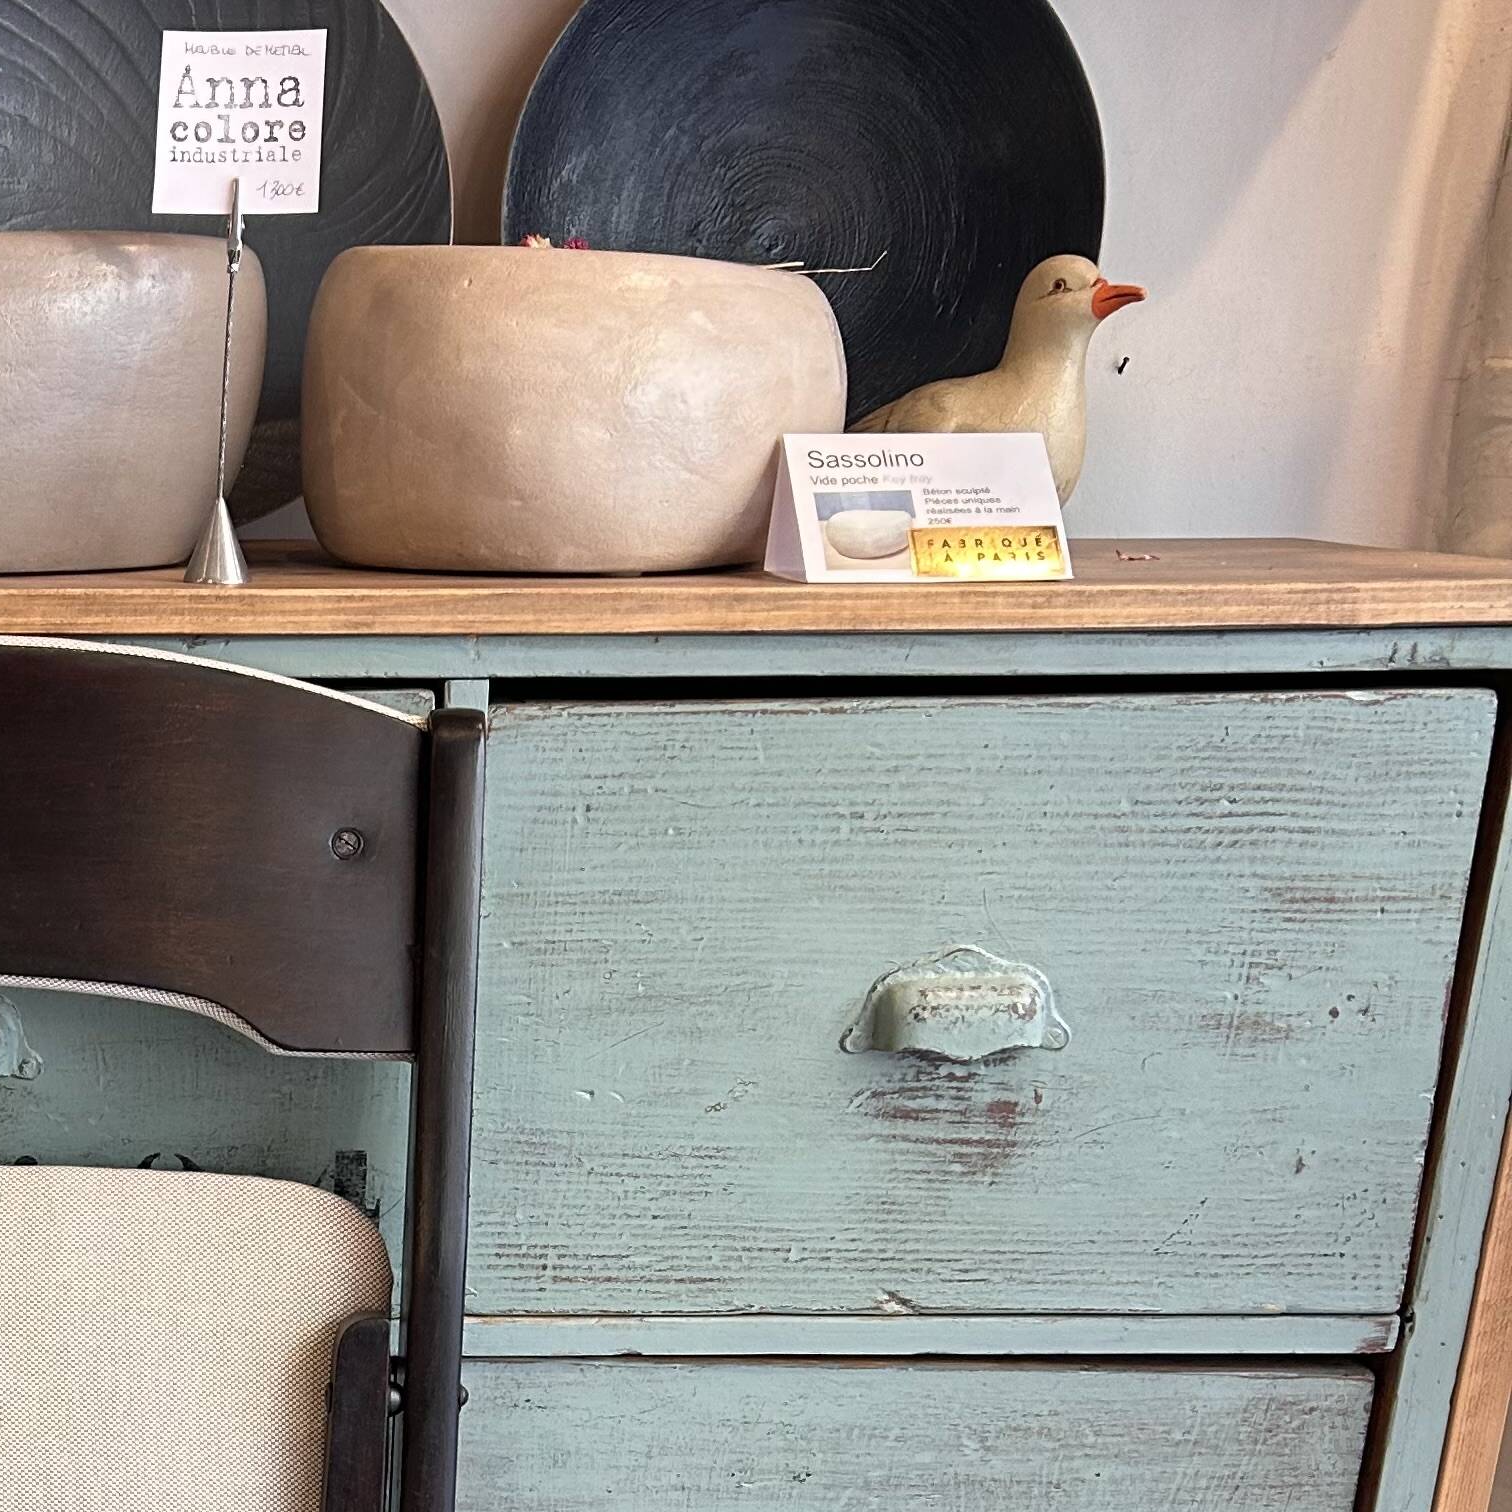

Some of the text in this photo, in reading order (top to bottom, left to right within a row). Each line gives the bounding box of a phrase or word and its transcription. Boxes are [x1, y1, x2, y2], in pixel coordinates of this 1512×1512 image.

[173, 64, 305, 109] Anna
[170, 114, 307, 143] colore
[169, 146, 302, 163] industriale
[807, 449, 924, 469] Sassolino
[810, 475, 837, 486] Vide
[841, 475, 879, 487] poche
[961, 497, 1001, 505] uniques
